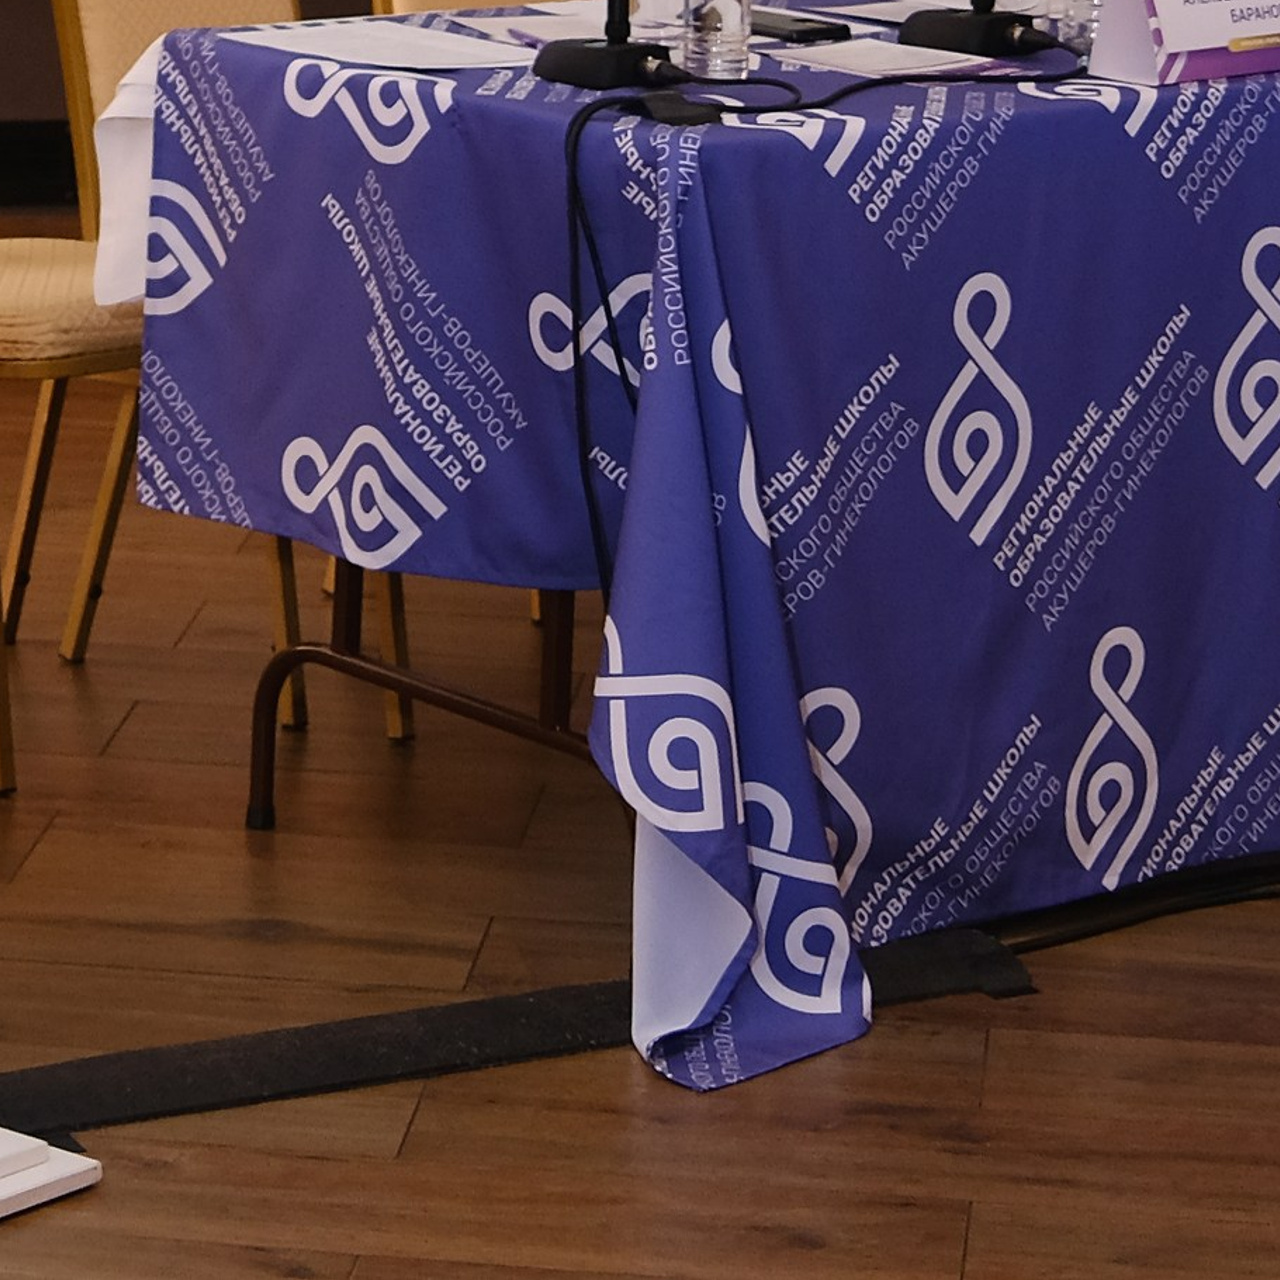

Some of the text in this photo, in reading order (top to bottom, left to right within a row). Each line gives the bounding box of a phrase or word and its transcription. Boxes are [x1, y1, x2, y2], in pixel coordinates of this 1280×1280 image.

[1230, 4, 1280, 23] БАРАНО
[321, 193, 487, 473] ОБРАЗОВАТЕЛЬНЫЕ ШКОЛЫ
[355, 188, 514, 451] РОССИЙСКОГО ОБЩЕСТВА
[365, 169, 528, 429] АКУШЕРОВ-ГИНЕКОЛОГОВ
[834, 353, 901, 440] ШКОЛЫ
[367, 326, 471, 492] РЕГИОНАЛЬНЫЕ
[828, 401, 906, 515] ОБЩЕСТВА
[993, 400, 1103, 571] РЕГИОНАЛЬНЫЕ
[1009, 303, 1191, 588] ОБРАЗОВАТЕЛЬНЫЕ ШКОЛЫ
[1025, 349, 1196, 613] РОССИЙСКОГО ОБЩЕСТВА
[1041, 364, 1210, 633] АКУШЕРОВ-ГИНЕКОЛОГОВ
[784, 417, 919, 620] РОВ-ГИНЕКОЛОГОВ
[851, 817, 950, 943] ИОНАЛЬНЫЕ
[870, 799, 988, 947] ЗОВАТЕЛЬНЫЕ
[982, 714, 1042, 803] ШКОЛЫ
[965, 760, 1047, 873] ОБЩЕСТВА
